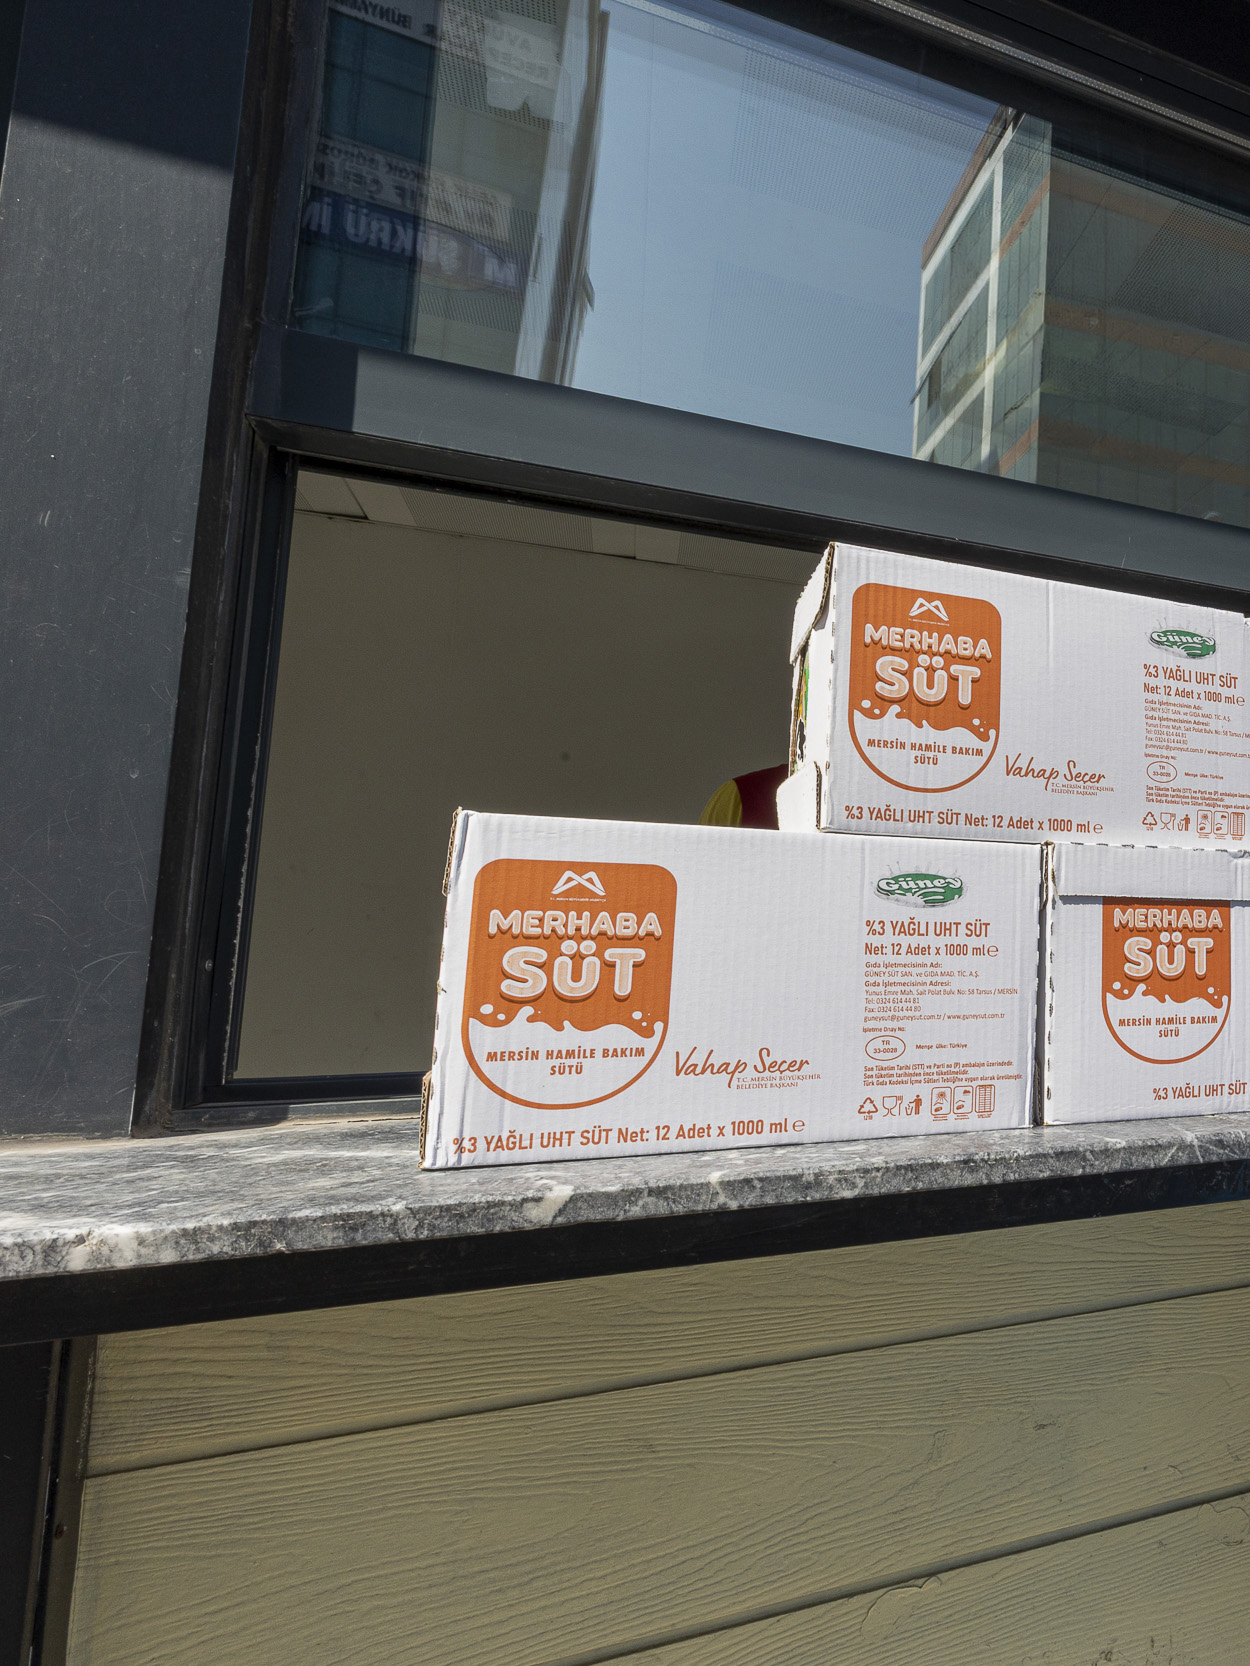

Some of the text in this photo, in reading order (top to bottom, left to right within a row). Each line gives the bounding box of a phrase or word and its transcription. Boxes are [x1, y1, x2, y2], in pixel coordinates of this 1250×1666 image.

[864, 623, 992, 661] MERHABA
[1152, 630, 1216, 646] Güney
[875, 655, 981, 708] SÜT
[1144, 664, 1238, 689] %3 YAĞLI UHT SÜT
[1144, 682, 1161, 695] Net:
[1163, 685, 1172, 696] 12
[1175, 687, 1194, 699] Adet
[1204, 690, 1222, 703] 1000
[867, 738, 983, 756] MERSİN HAMİLE BAKIM
[914, 754, 938, 765] SÜTÜ
[1005, 753, 1106, 791] Vahap Seçer
[845, 803, 1090, 833] %3 YAĞLI UHT SÜT Net: 12 Adet x 1000 ml
[877, 876, 963, 892] Güney
[488, 909, 662, 939] MERHABA
[866, 917, 990, 937] %3 YAĞLI UHT SÜT
[1114, 908, 1222, 932] MERHABA
[865, 943, 887, 955] Net:
[891, 943, 902, 956] 12
[906, 944, 931, 956] Adet
[935, 947, 940, 955] x
[945, 944, 968, 956] 1000
[1123, 932, 1213, 980] SÜT
[499, 940, 646, 1000] SÜT
[1119, 1015, 1218, 1027] MERSİN HAMİLE BAKIM
[1159, 1027, 1179, 1038] SÜTÜ
[486, 1046, 645, 1062] MERSİN HAMİLE BAKIM
[550, 1062, 583, 1076] SÜTÜ
[676, 1047, 810, 1088] Vahap Seçer
[1153, 1088, 1168, 1100] %3
[1172, 1083, 1201, 1099] YAĞLI
[1204, 1084, 1225, 1097] UHT
[1228, 1080, 1247, 1095] SÜT
[452, 1118, 788, 1155] %3 YAĞLI UHT SÜT Net: 12 Adet x 1000 ml
